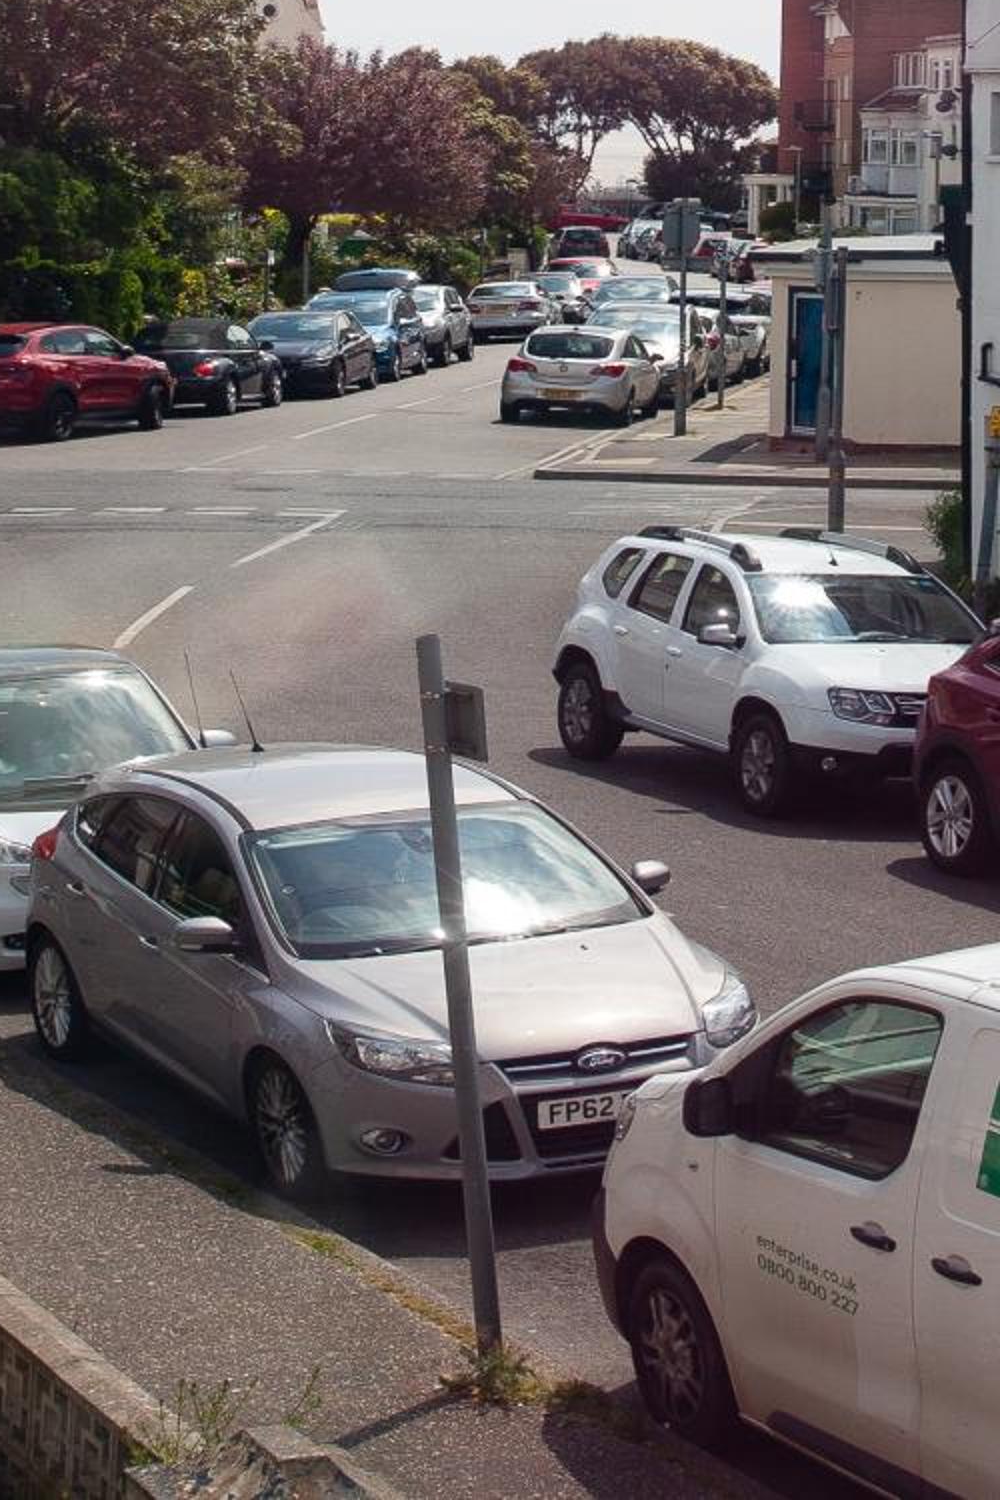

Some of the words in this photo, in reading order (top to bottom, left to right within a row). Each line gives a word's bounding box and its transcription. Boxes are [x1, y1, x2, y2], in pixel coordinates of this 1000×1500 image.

[549, 1096, 614, 1125] FP62
[757, 1235, 857, 1293] enterprise.co.uk
[757, 1253, 795, 1284] 0800
[798, 1275, 827, 1301] 800
[830, 1290, 859, 1316] 227
